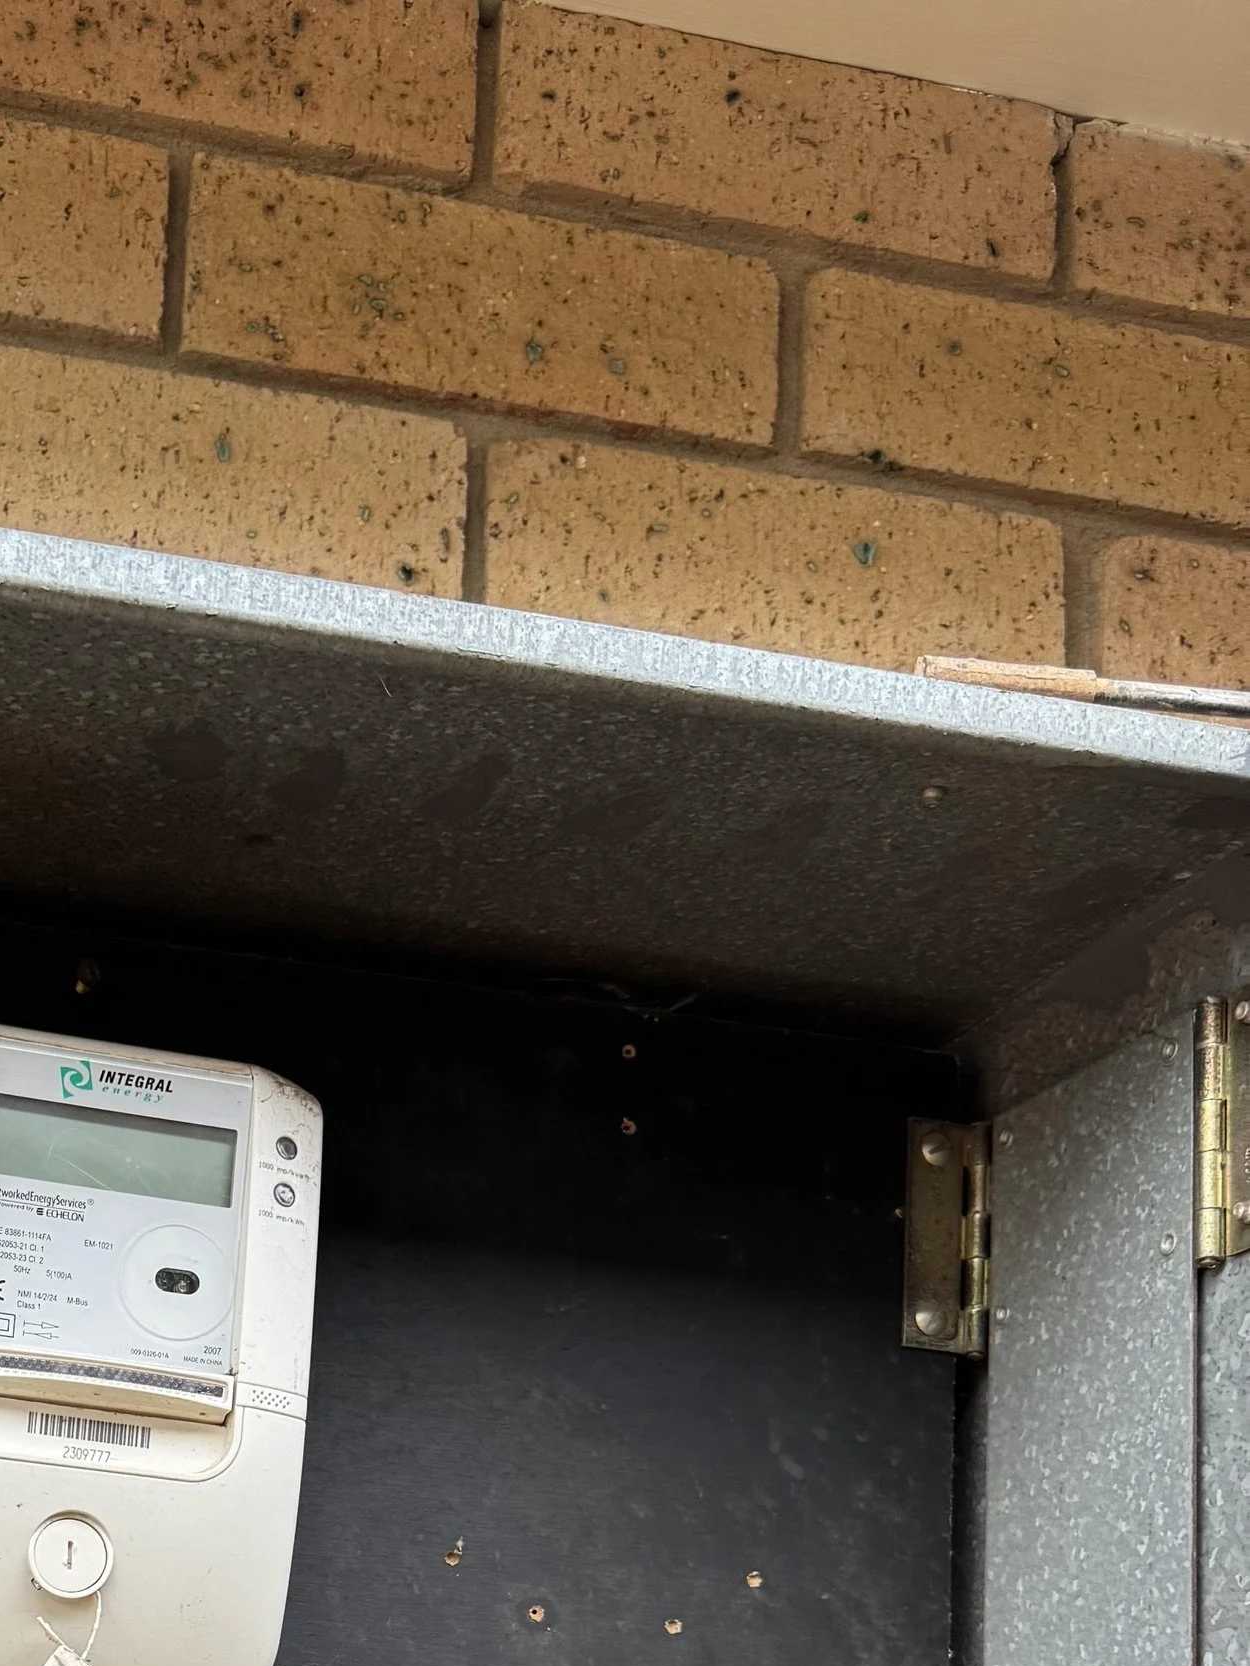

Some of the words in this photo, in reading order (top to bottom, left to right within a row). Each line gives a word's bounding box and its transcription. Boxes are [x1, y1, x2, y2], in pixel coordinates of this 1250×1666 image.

[99, 1070, 173, 1093] INTEGRAL
[102, 1086, 163, 1103] energy
[258, 1161, 274, 1170] 1000
[26, 1204, 34, 1212] by
[46, 1209, 84, 1222] ECHELON
[258, 1209, 273, 1218] 1000
[84, 1239, 113, 1250] EM-1021
[13, 1265, 31, 1275] 50Hz
[46, 1269, 72, 1280] 5(100)A
[17, 1290, 31, 1299] NMI
[33, 1292, 57, 1302] 14/2/24
[67, 1296, 88, 1306] M-Bus
[16, 1300, 35, 1310] Class
[203, 1345, 222, 1356] 2007
[183, 1356, 198, 1364] MADE
[63, 1446, 111, 1463] 2309777
